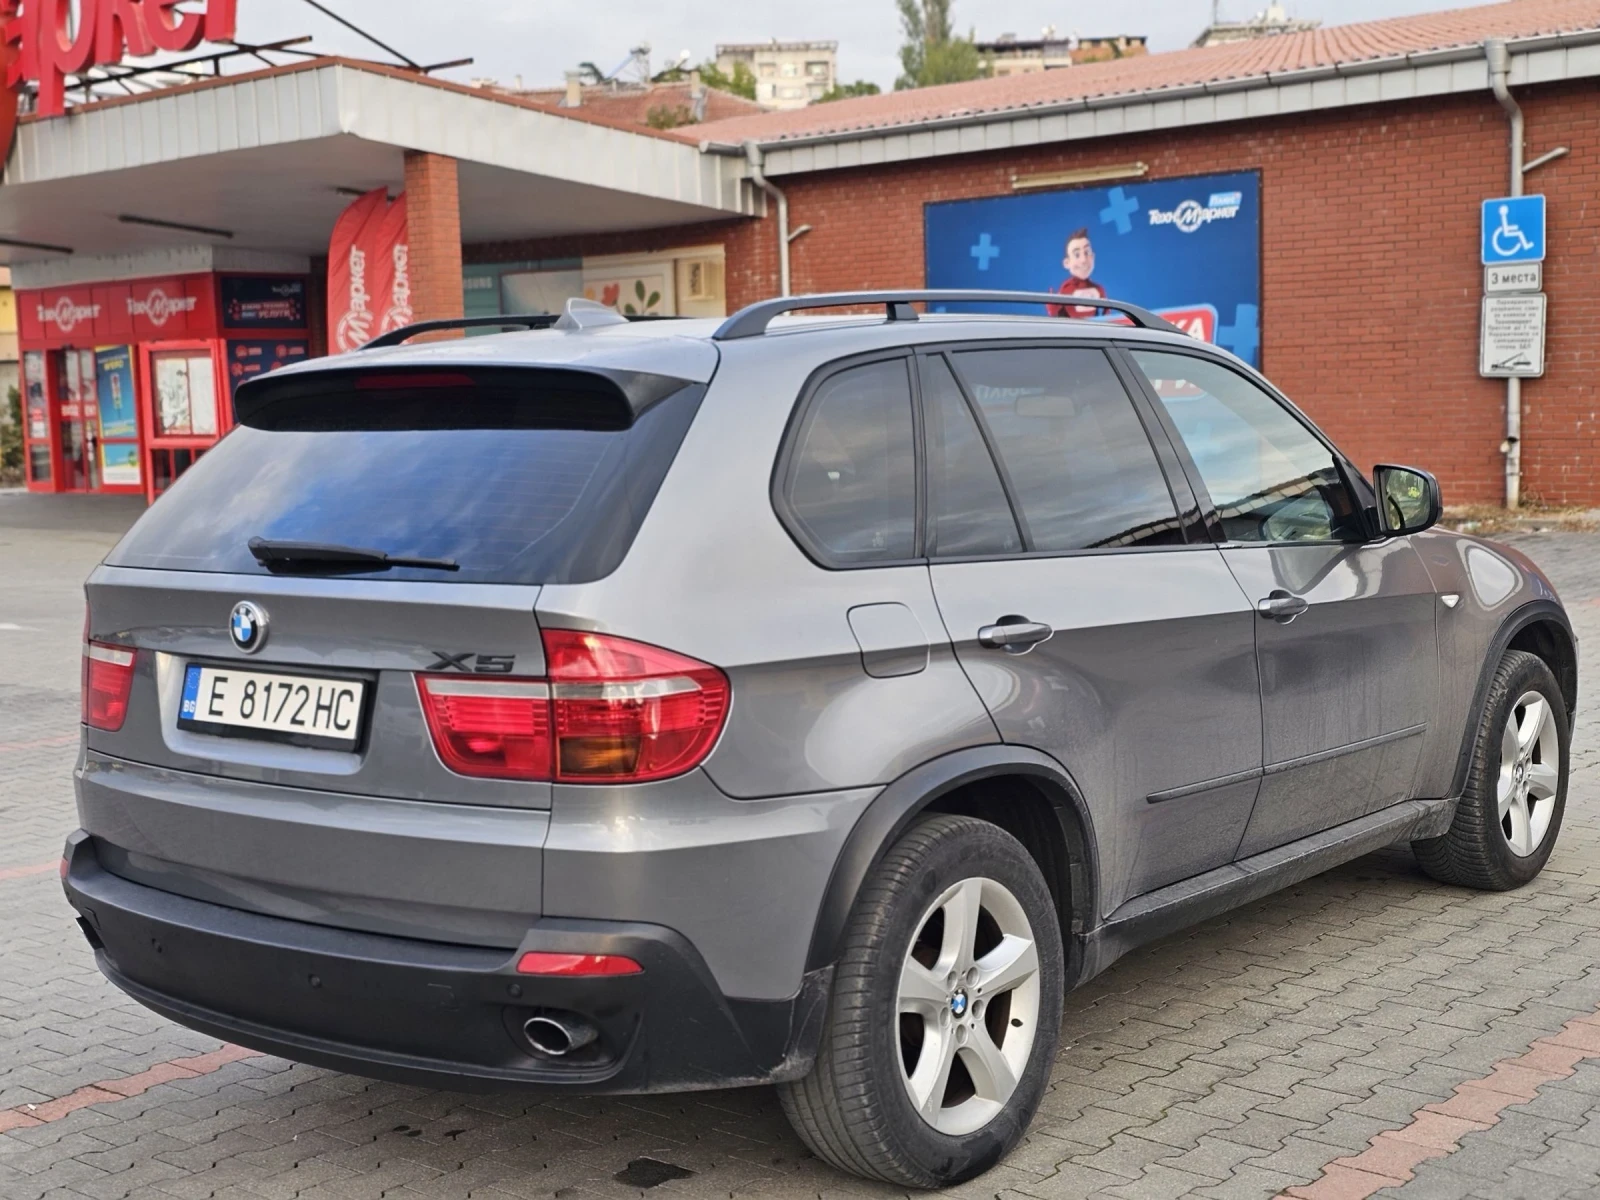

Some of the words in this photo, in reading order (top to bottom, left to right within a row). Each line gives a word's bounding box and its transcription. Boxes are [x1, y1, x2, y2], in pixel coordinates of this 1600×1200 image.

[1491, 272, 1499, 285] 3
[1501, 273, 1537, 285] места
[425, 651, 516, 673] X5
[208, 675, 229, 717] E
[183, 700, 197, 714] BG
